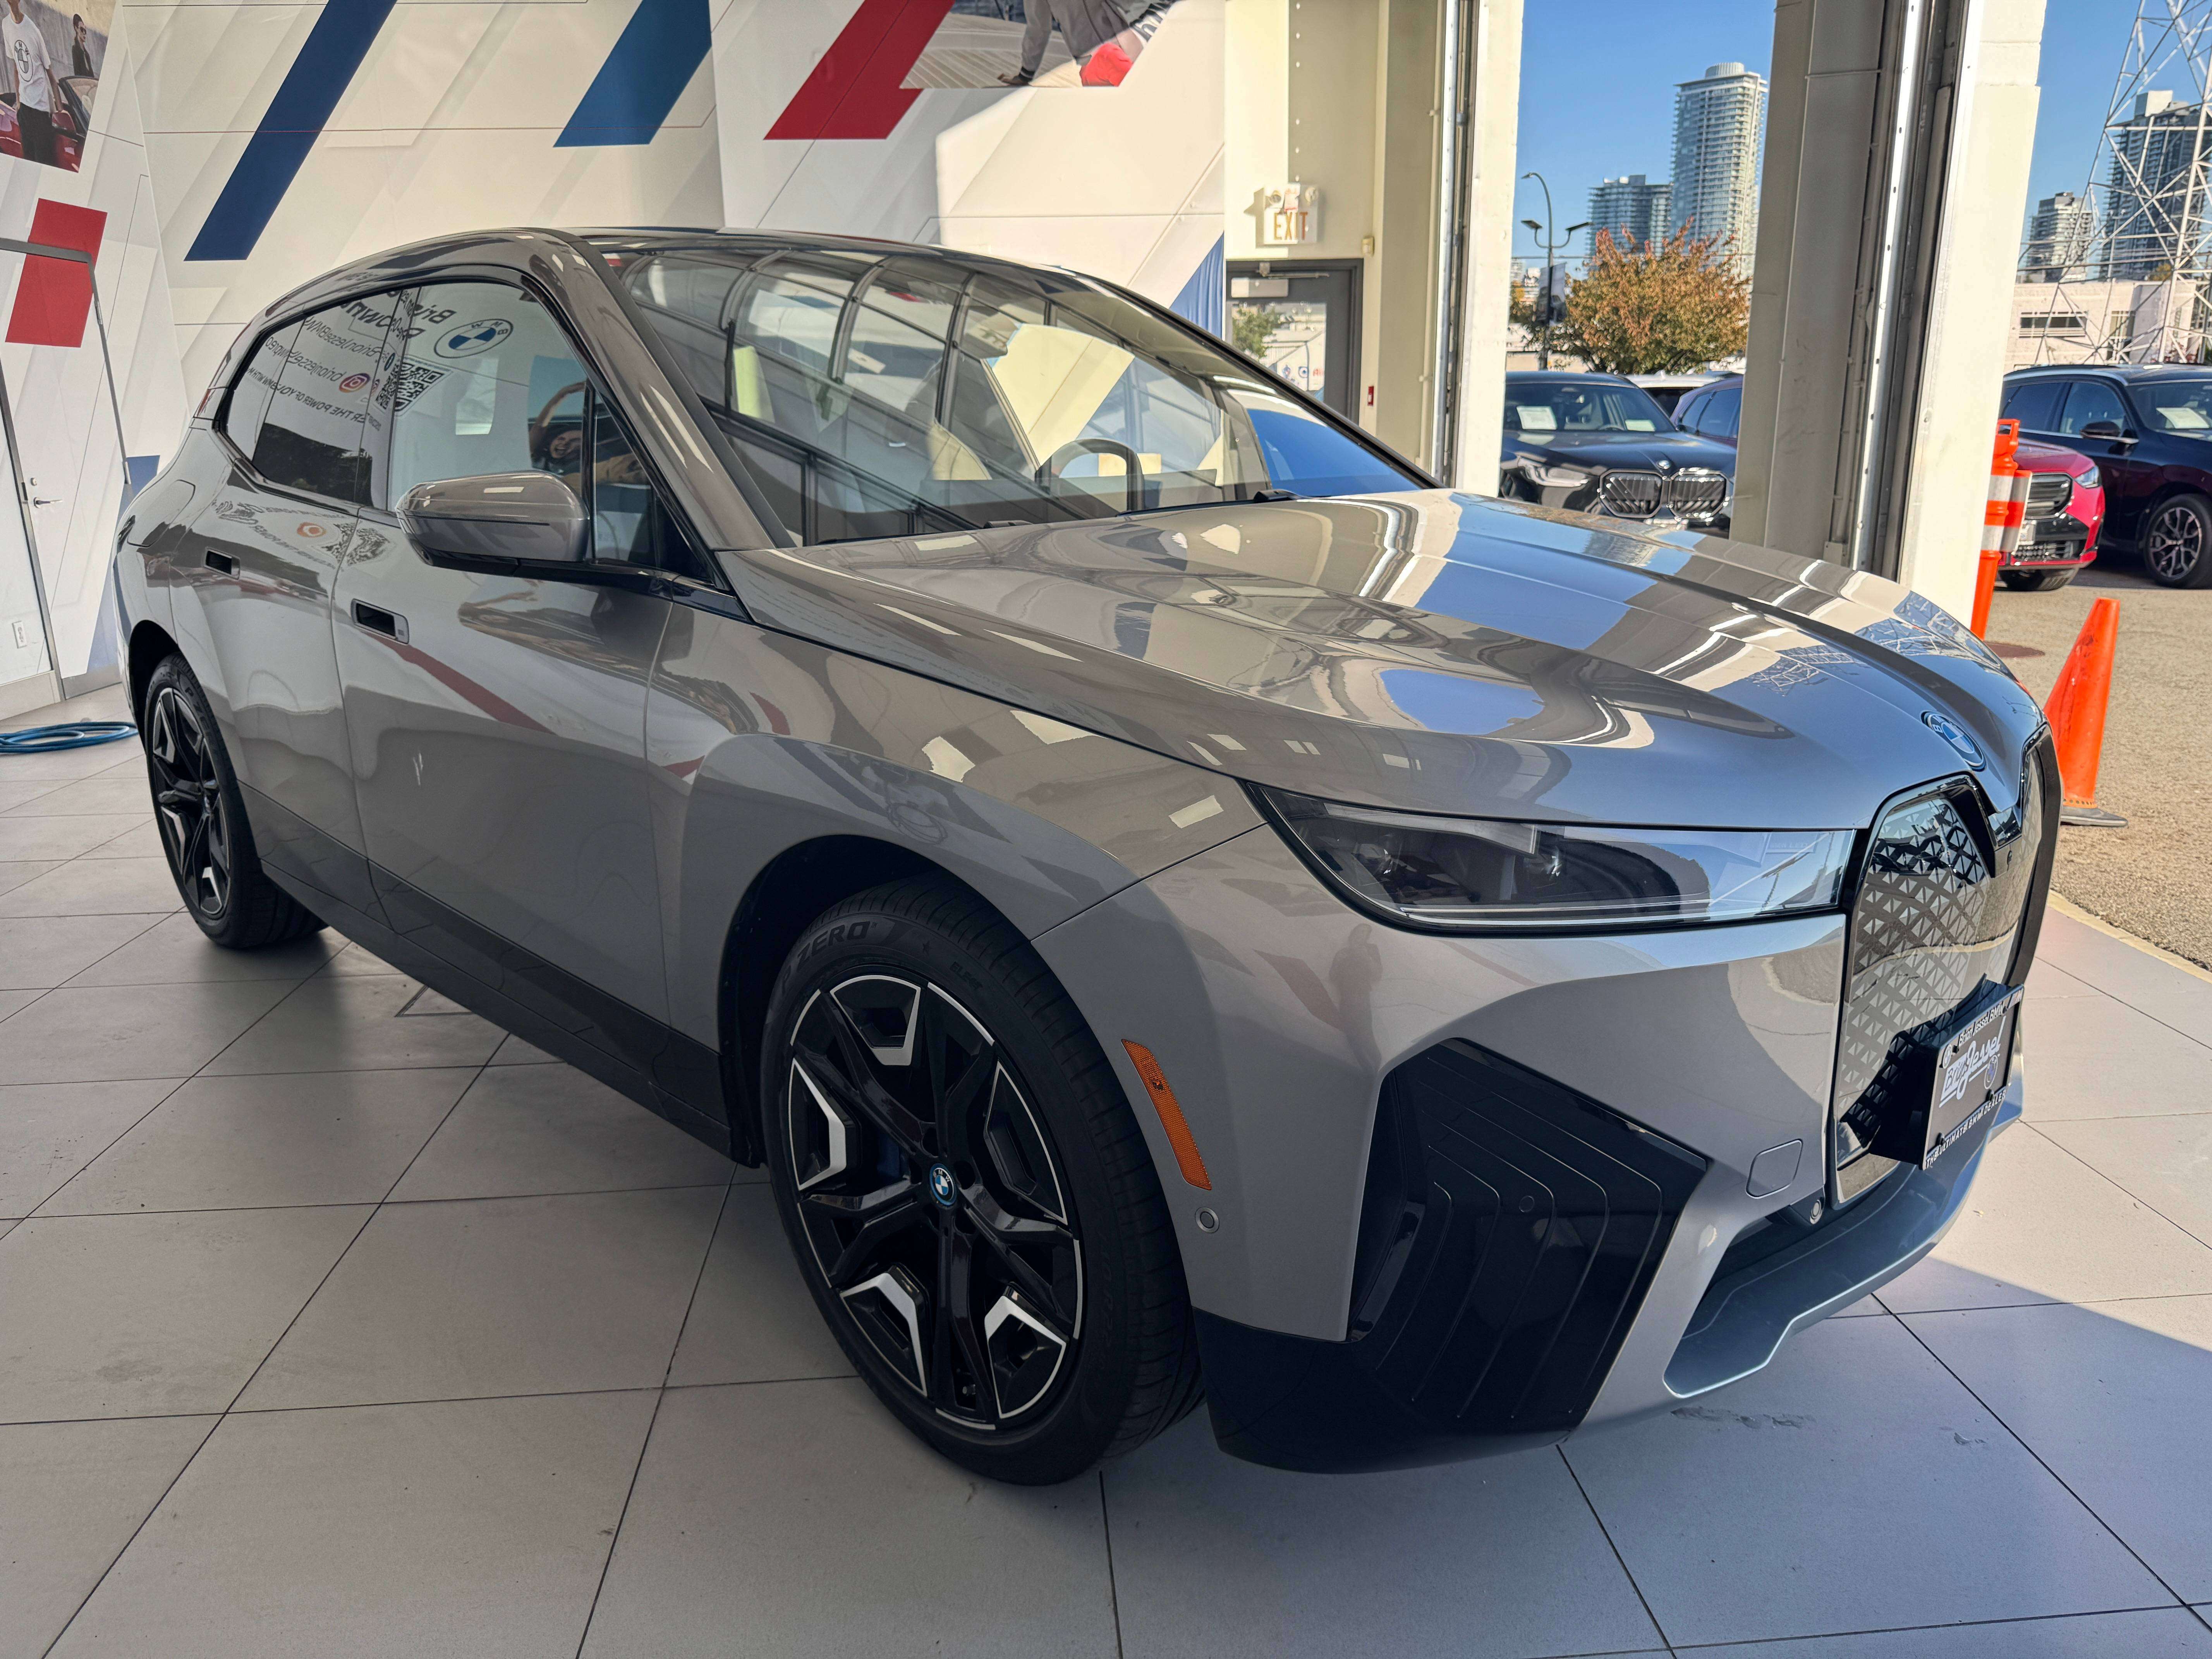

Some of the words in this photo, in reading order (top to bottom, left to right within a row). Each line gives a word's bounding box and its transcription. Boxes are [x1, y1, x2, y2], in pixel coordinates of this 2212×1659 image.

[1274, 211, 1308, 240] EXIT
[796, 921, 871, 972] ZERO
[1956, 1015, 2006, 1100] Jessel
[1927, 1149, 1939, 1168] THE
[1939, 1121, 1968, 1155] ULTIMATE
[1968, 1108, 1984, 1129] BMW
[1984, 1089, 2006, 1115] DEALER
